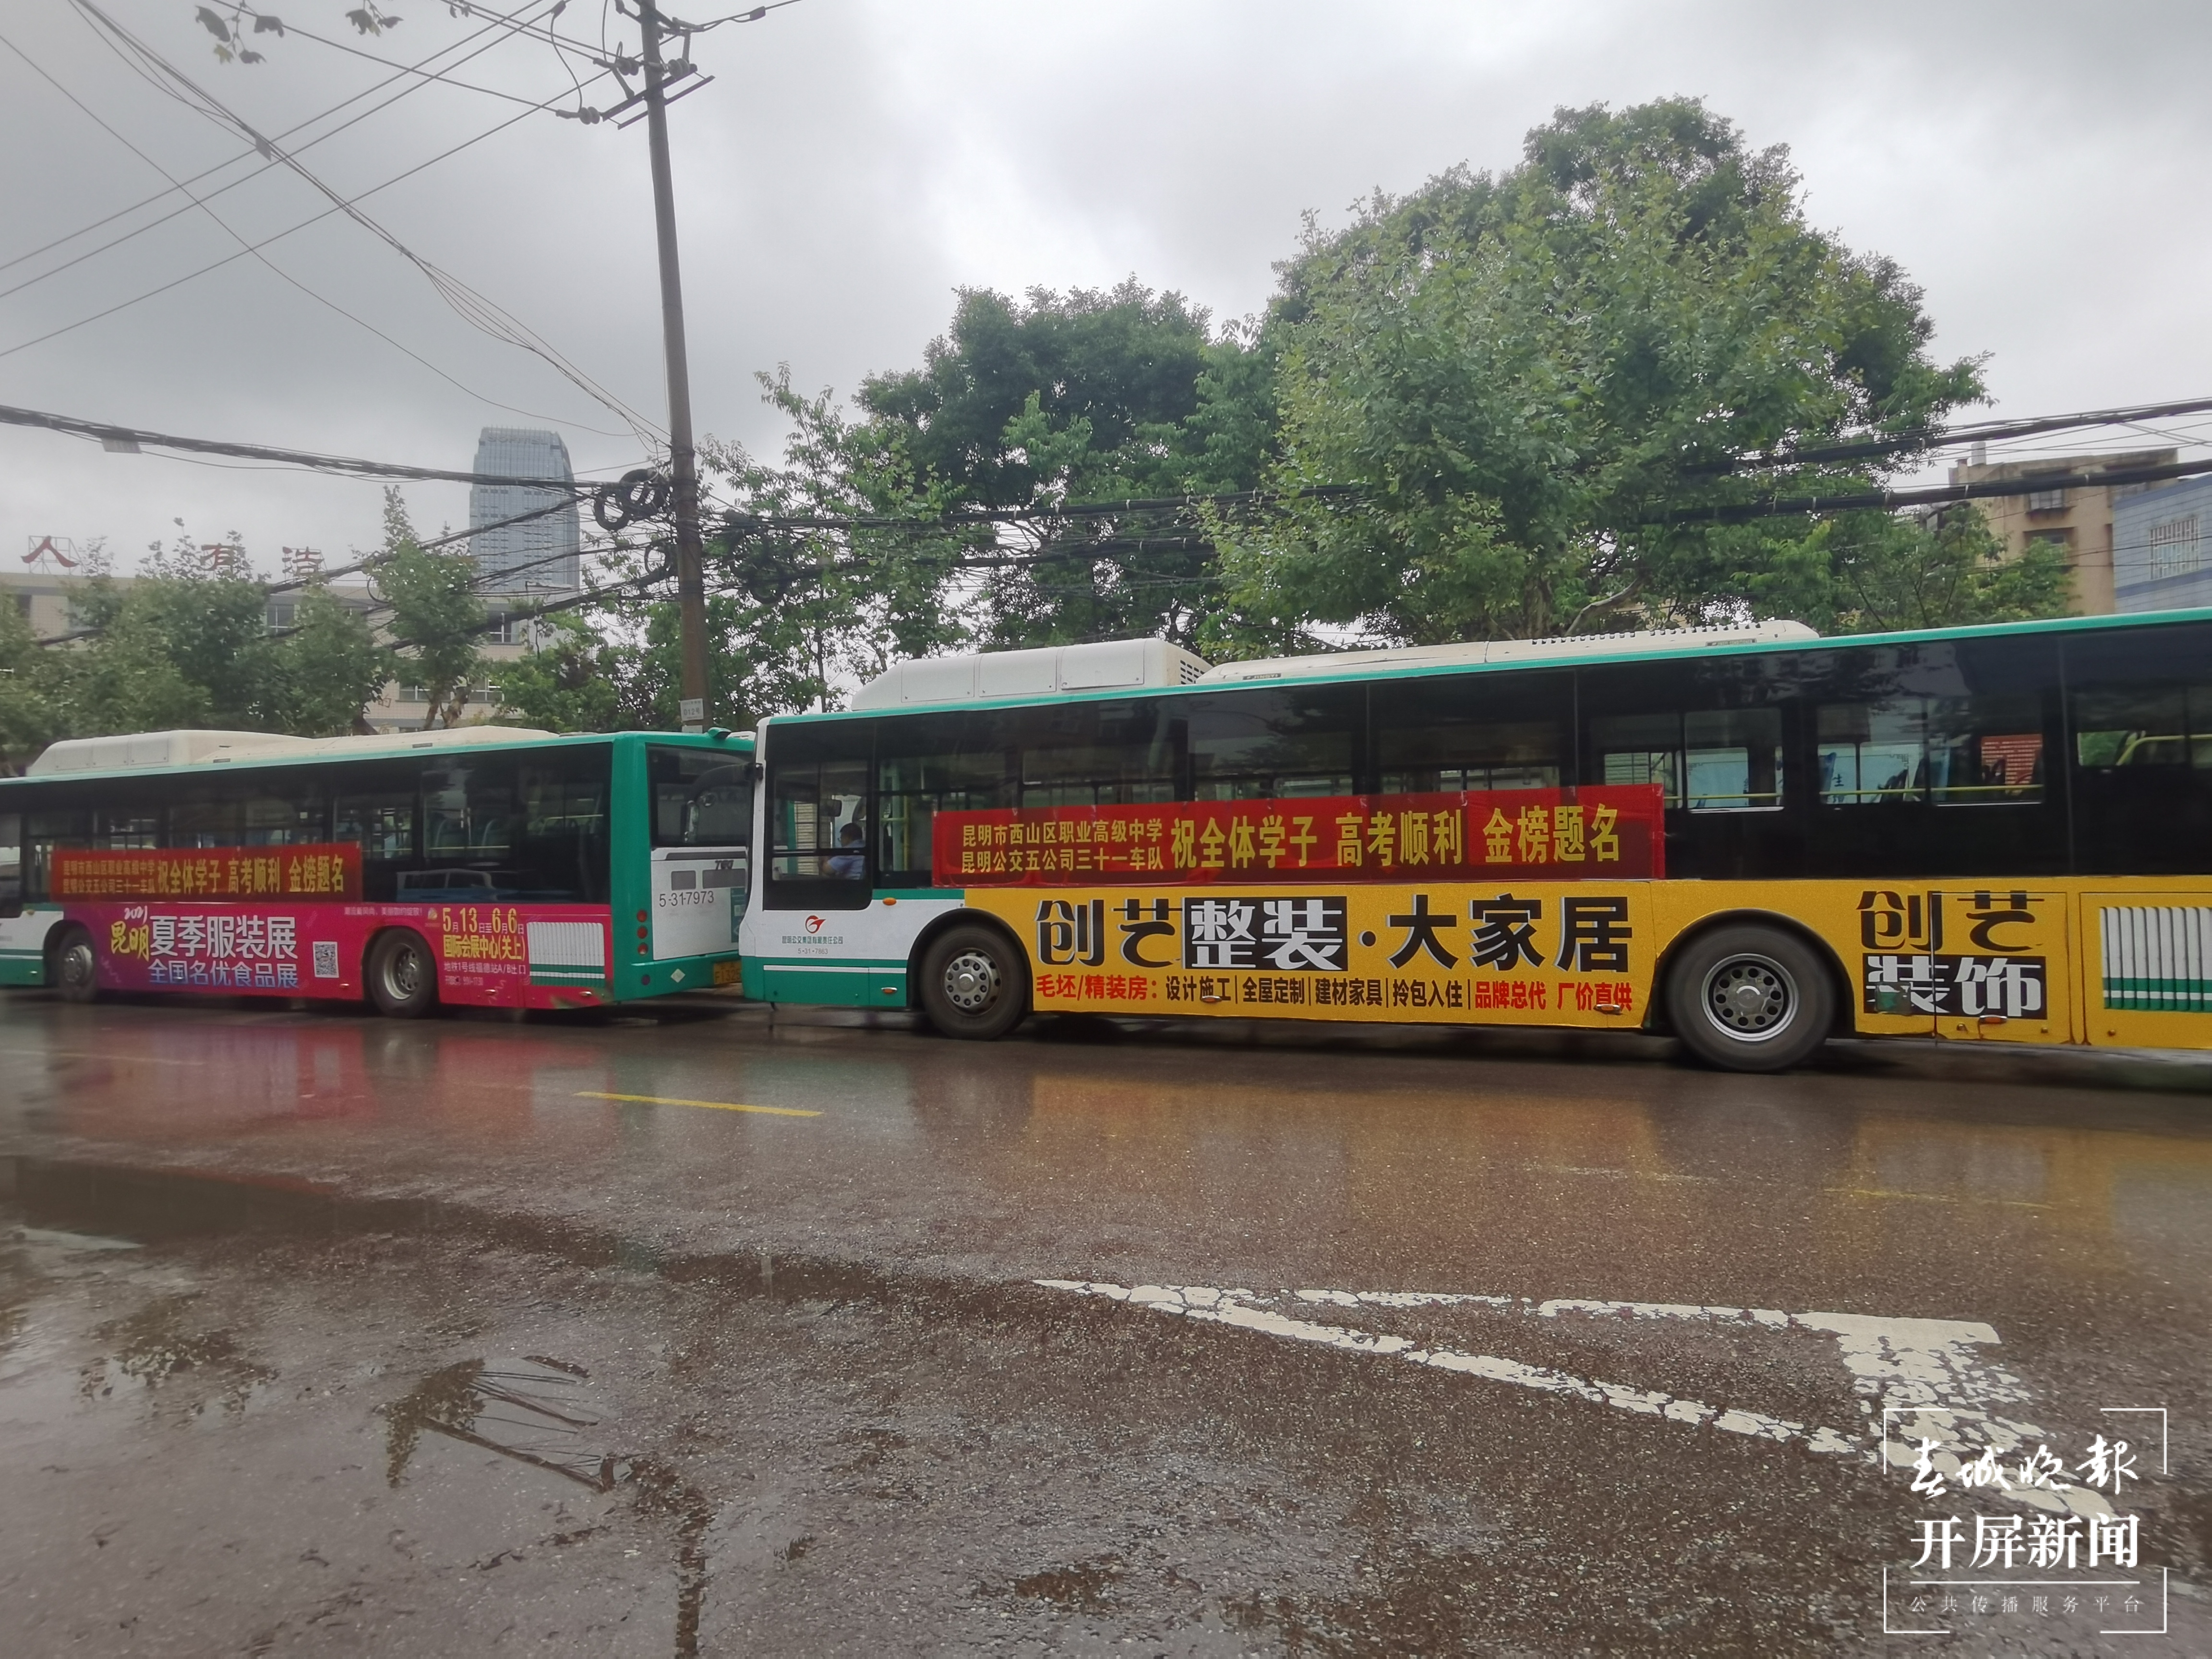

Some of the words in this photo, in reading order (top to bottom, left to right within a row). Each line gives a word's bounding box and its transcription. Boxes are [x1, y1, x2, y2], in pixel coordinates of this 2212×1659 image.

[963, 819, 1163, 847] 昆明市西山区职业高级中学
[1171, 815, 1318, 869] 祝全体学子
[1336, 809, 1463, 867] 高考顺利
[1483, 804, 1620, 863] 金榜题名
[158, 858, 221, 894] 祝全体学子
[228, 857, 280, 894] 高考顺利
[289, 854, 344, 893] 金榜题名
[962, 847, 1164, 874] 昆明公交五公司三十一车队
[110, 920, 150, 962] 昆明
[150, 914, 299, 960] 夏季服装展
[1856, 890, 2045, 952] 创艺
[147, 959, 300, 989] 全国名优食品展
